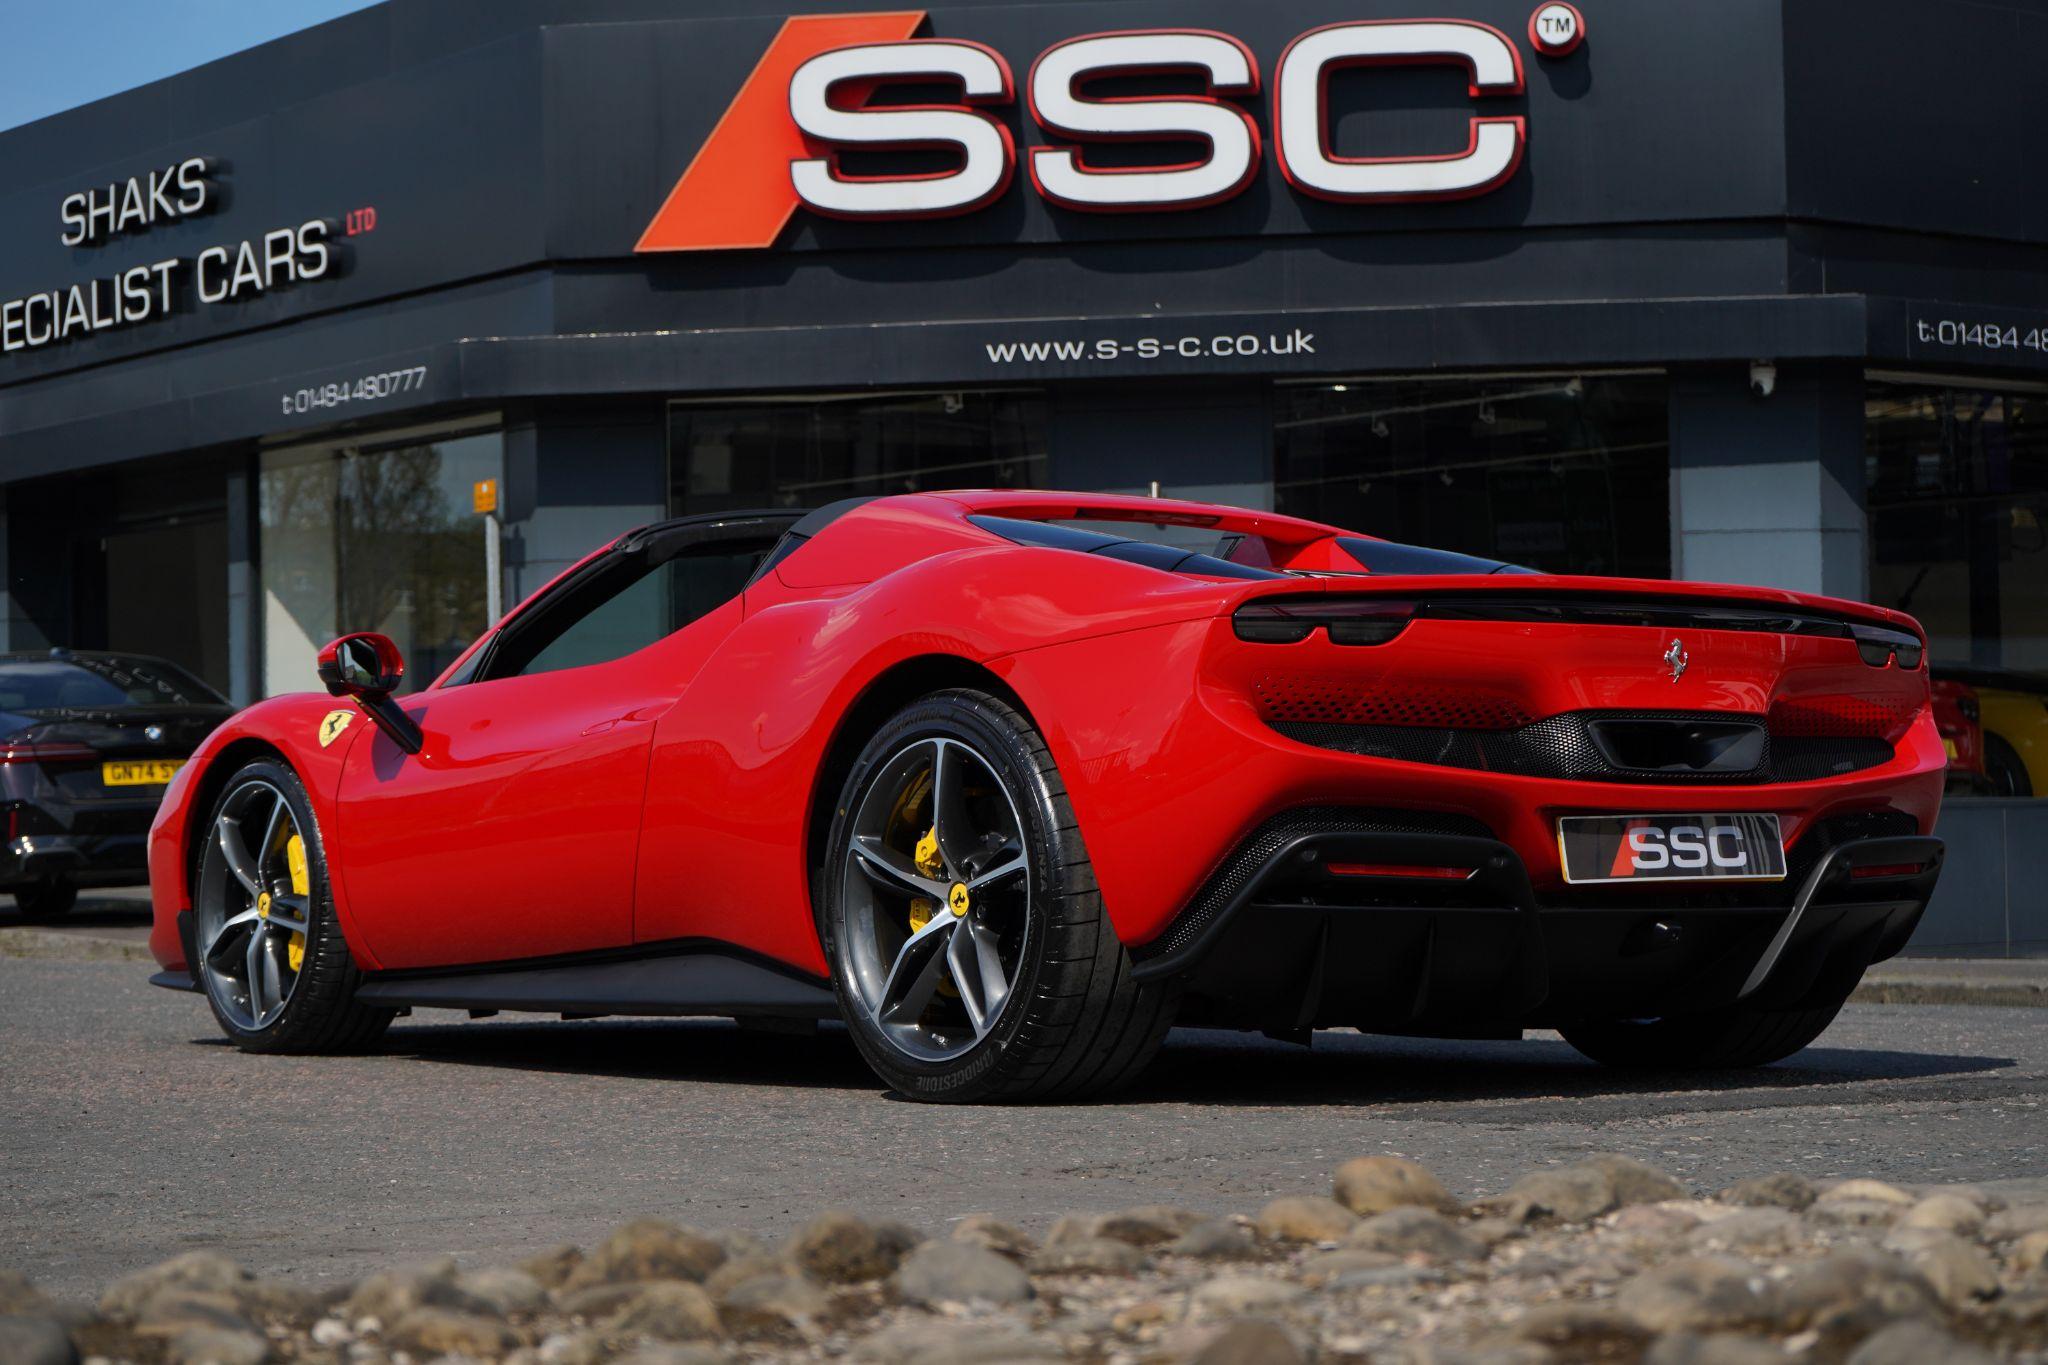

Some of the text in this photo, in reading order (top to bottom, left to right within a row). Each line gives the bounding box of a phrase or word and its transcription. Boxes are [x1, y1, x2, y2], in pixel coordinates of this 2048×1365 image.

[789, 17, 1570, 219] SSC TM
[61, 157, 206, 247] SHAKS
[0, 206, 377, 351] ECIALIST CARS LTD
[985, 328, 1316, 363] www.s-s-c.co.uk
[1628, 825, 1747, 870] SSC
[915, 1046, 994, 1092] BRIDGESTONE
